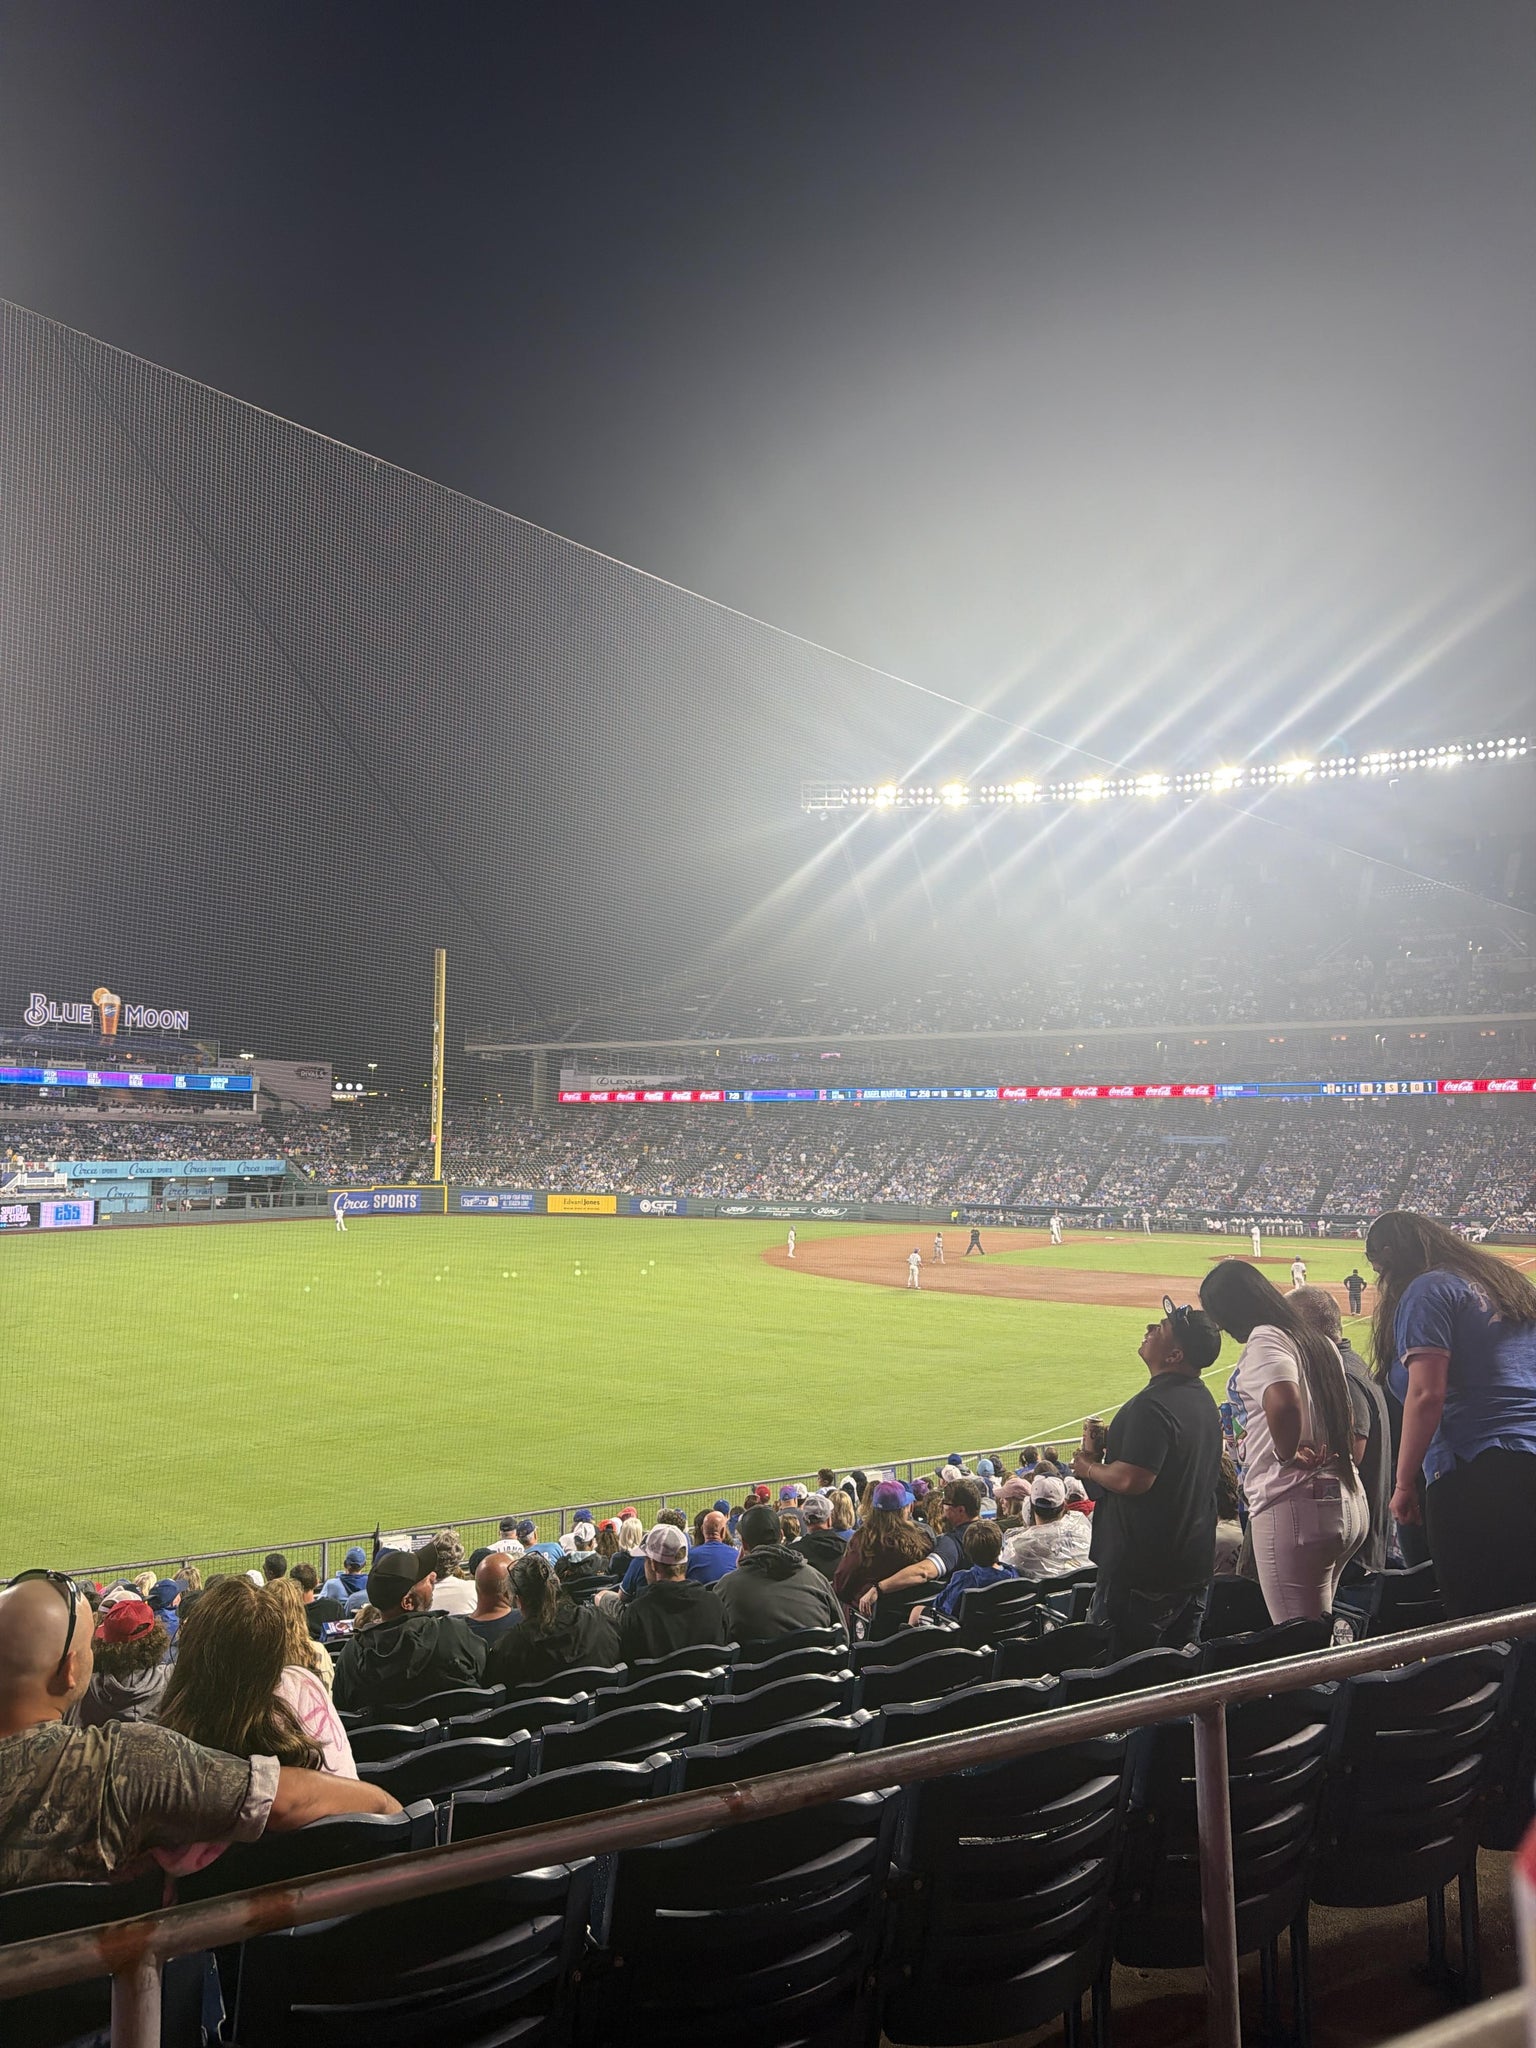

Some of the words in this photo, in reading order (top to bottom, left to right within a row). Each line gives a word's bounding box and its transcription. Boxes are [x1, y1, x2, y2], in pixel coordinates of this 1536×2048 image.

[24, 993, 92, 1027] BLUE
[125, 1004, 189, 1030] MOON
[1376, 1084, 1382, 1092] 2
[1402, 1084, 1408, 1092] 2
[1444, 1081, 1474, 1092] Coca-Cola
[1488, 1080, 1518, 1090] Coca-Cola
[1003, 1088, 1026, 1097] Coca-Cola
[1038, 1088, 1062, 1096] Coca-Cola
[1072, 1087, 1098, 1096] Coca-Cola
[1109, 1087, 1133, 1096] Coca-Cola
[1146, 1086, 1171, 1096] Coca-Cola
[1184, 1086, 1209, 1095] Coca-Cola
[72, 1163, 98, 1177] Circa
[128, 1162, 153, 1176] Circa
[184, 1162, 208, 1175] Circa
[237, 1162, 260, 1174] Circa
[107, 1186, 135, 1202] Circa
[334, 1192, 370, 1210] Circa
[373, 1194, 416, 1209] SPORTS
[584, 1198, 600, 1206] Jones
